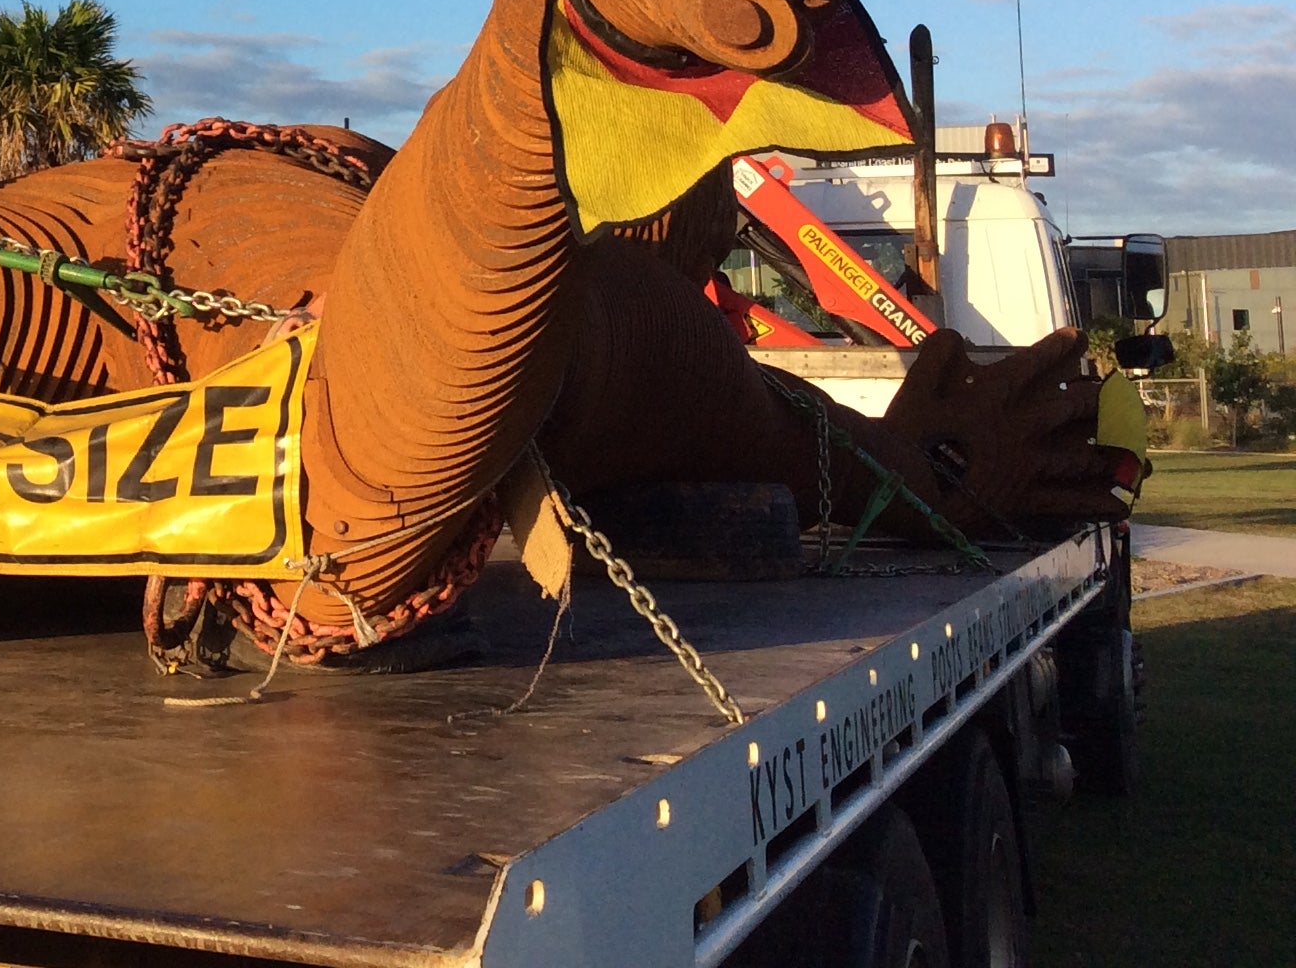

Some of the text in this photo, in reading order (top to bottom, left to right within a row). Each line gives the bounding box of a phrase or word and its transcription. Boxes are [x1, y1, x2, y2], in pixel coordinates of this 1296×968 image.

[802, 228, 873, 295] PALFINGER
[749, 737, 806, 846] KYST
[820, 673, 915, 789] ENGINEERING
